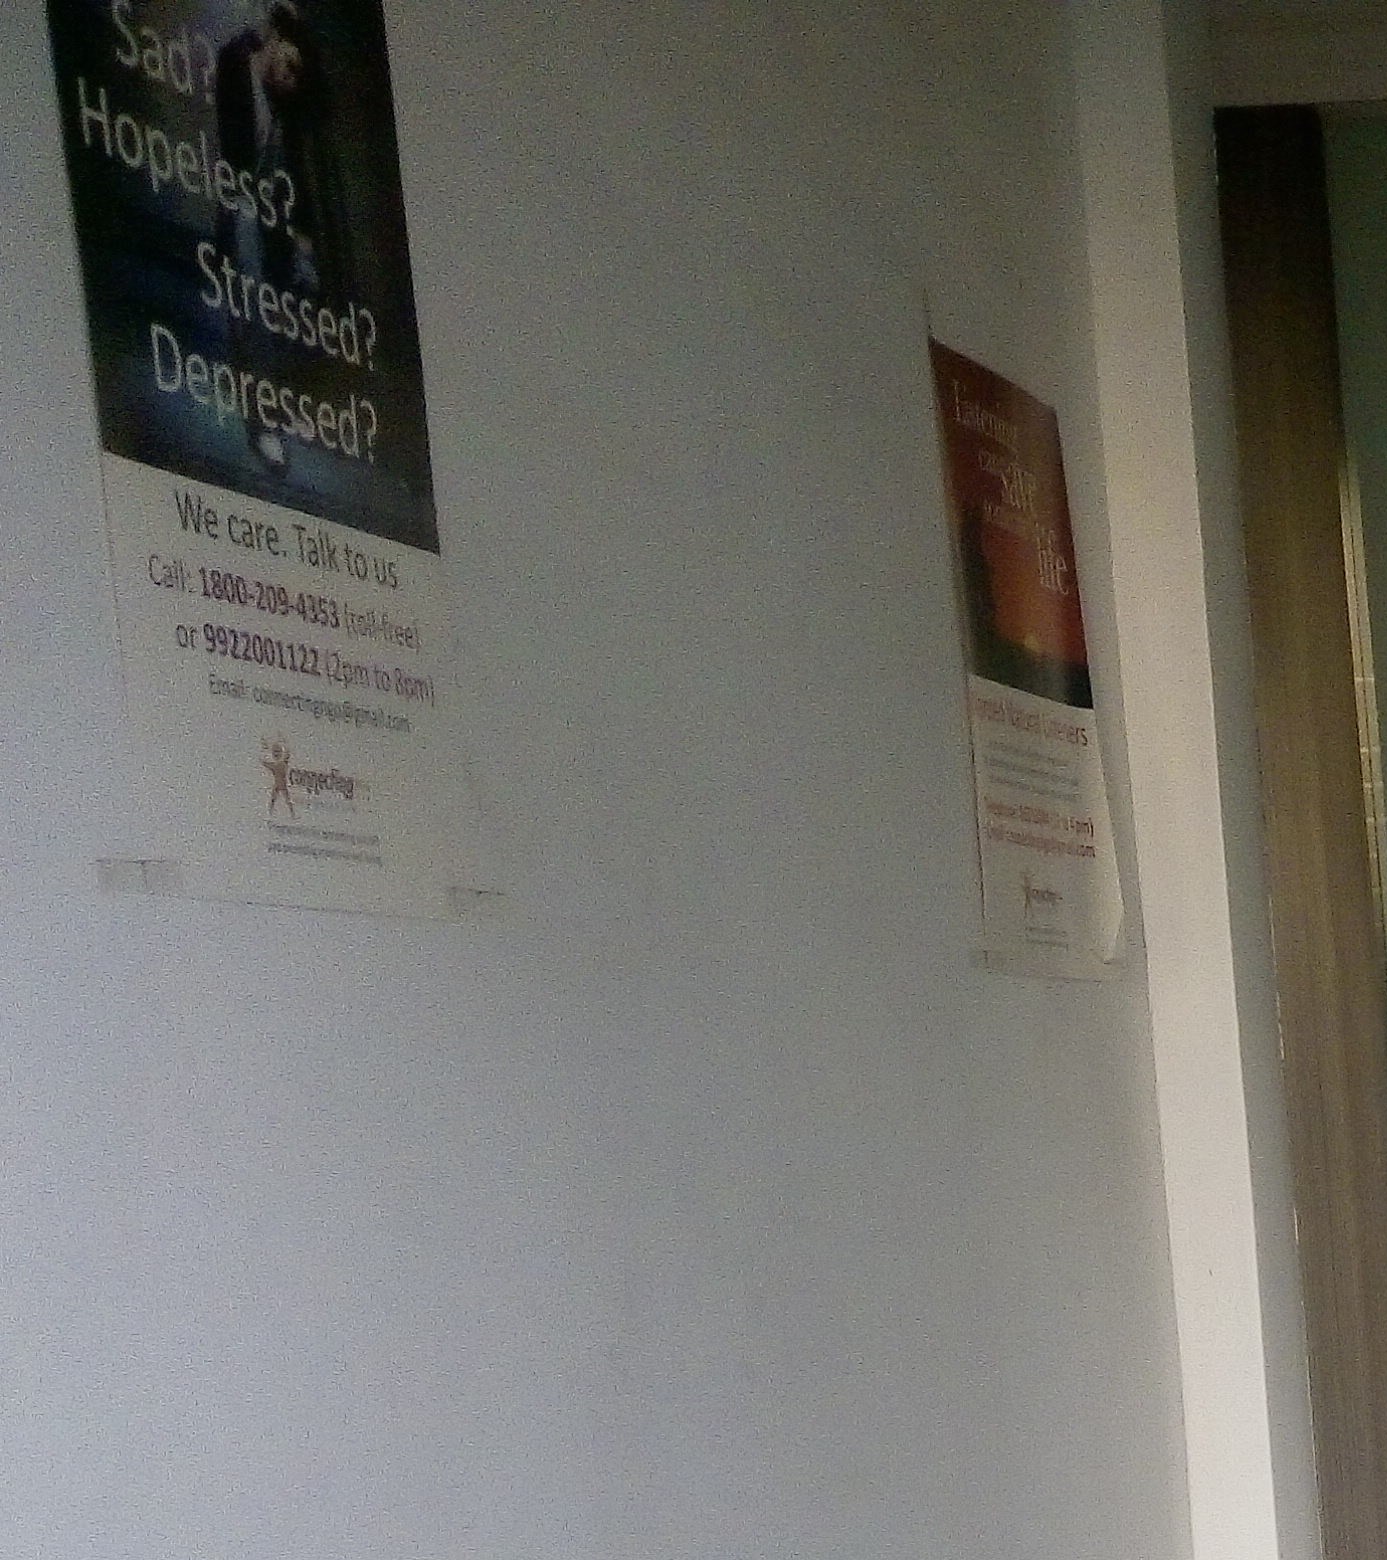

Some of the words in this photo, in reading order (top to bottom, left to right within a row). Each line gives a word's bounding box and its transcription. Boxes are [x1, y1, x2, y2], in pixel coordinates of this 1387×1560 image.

[78, 76, 296, 233] Hopeless?
[197, 242, 376, 371] Stressed?
[150, 323, 377, 464] Depressed?
[176, 491, 219, 540] We
[227, 513, 287, 557] care.
[290, 524, 340, 573] Talk
[347, 543, 367, 581] to
[374, 557, 399, 588] us
[199, 566, 340, 630] 1800-209-4353
[176, 624, 199, 650] or
[203, 623, 320, 677] 9922001122
[326, 651, 369, 689] (2pm
[372, 659, 391, 692] to
